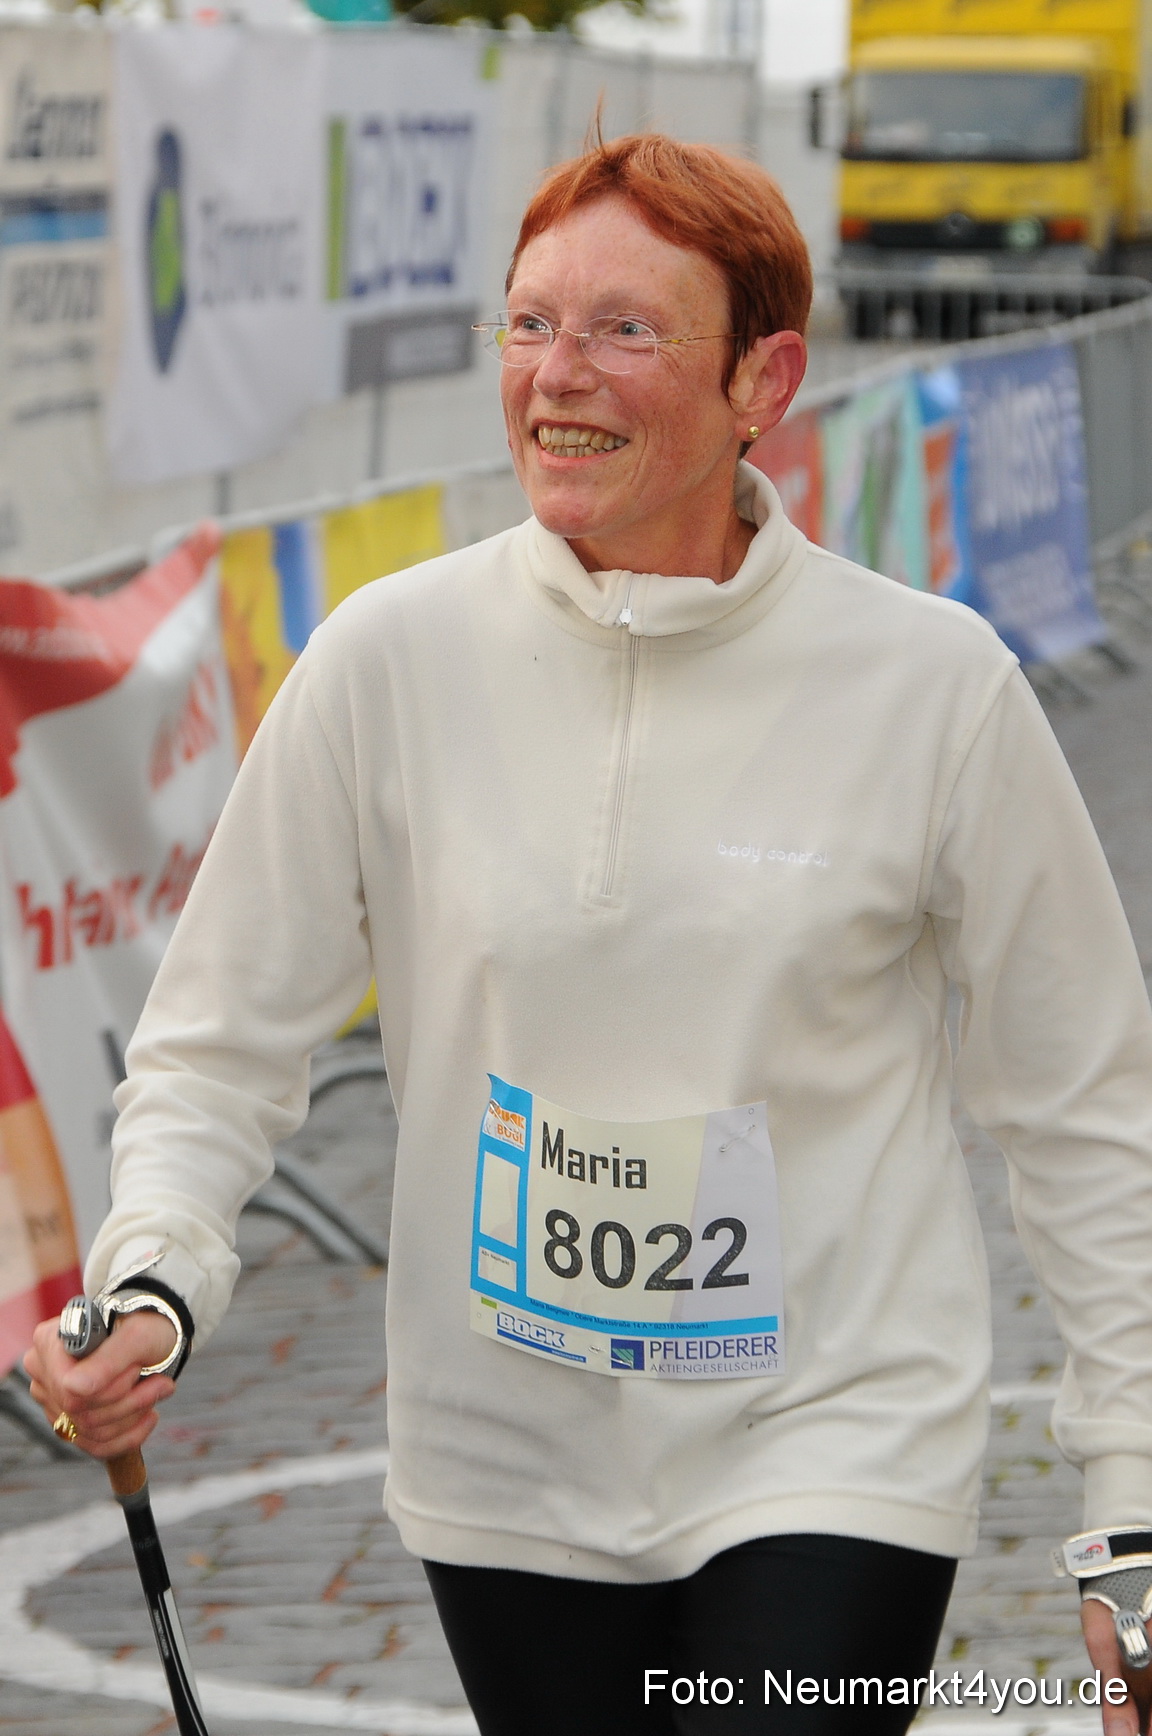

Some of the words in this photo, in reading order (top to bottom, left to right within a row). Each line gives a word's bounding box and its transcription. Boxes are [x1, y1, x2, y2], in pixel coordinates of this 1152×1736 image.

[717, 838, 761, 863] body
[541, 1120, 648, 1190] Maria
[543, 1208, 750, 1291] 8022
[496, 1311, 566, 1349] BOCK
[650, 1335, 778, 1360] PFLEIDERER
[650, 1359, 779, 1374] AKTIENGESELLSCHAFT
